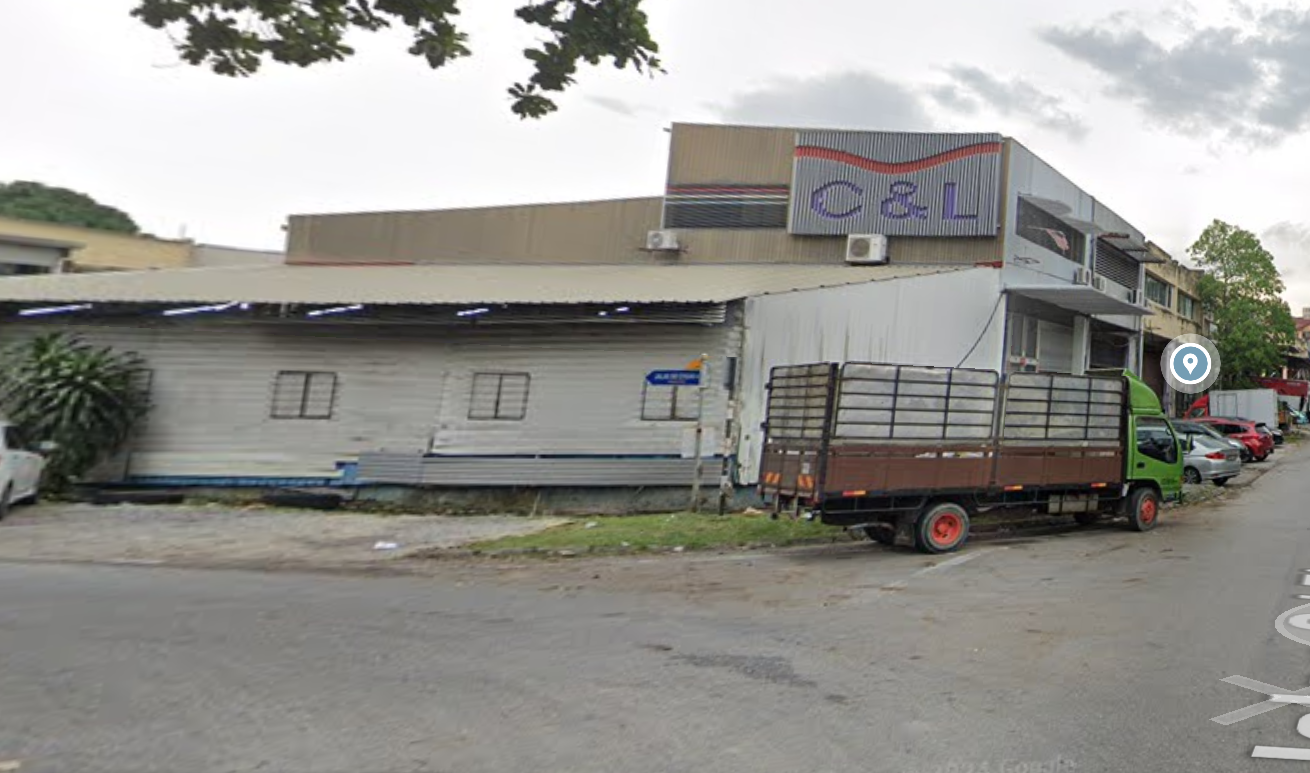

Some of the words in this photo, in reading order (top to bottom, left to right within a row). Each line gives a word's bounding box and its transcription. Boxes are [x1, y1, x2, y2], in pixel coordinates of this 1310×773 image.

[811, 180, 863, 219] C
[881, 180, 928, 220] &
[942, 182, 978, 220] L
